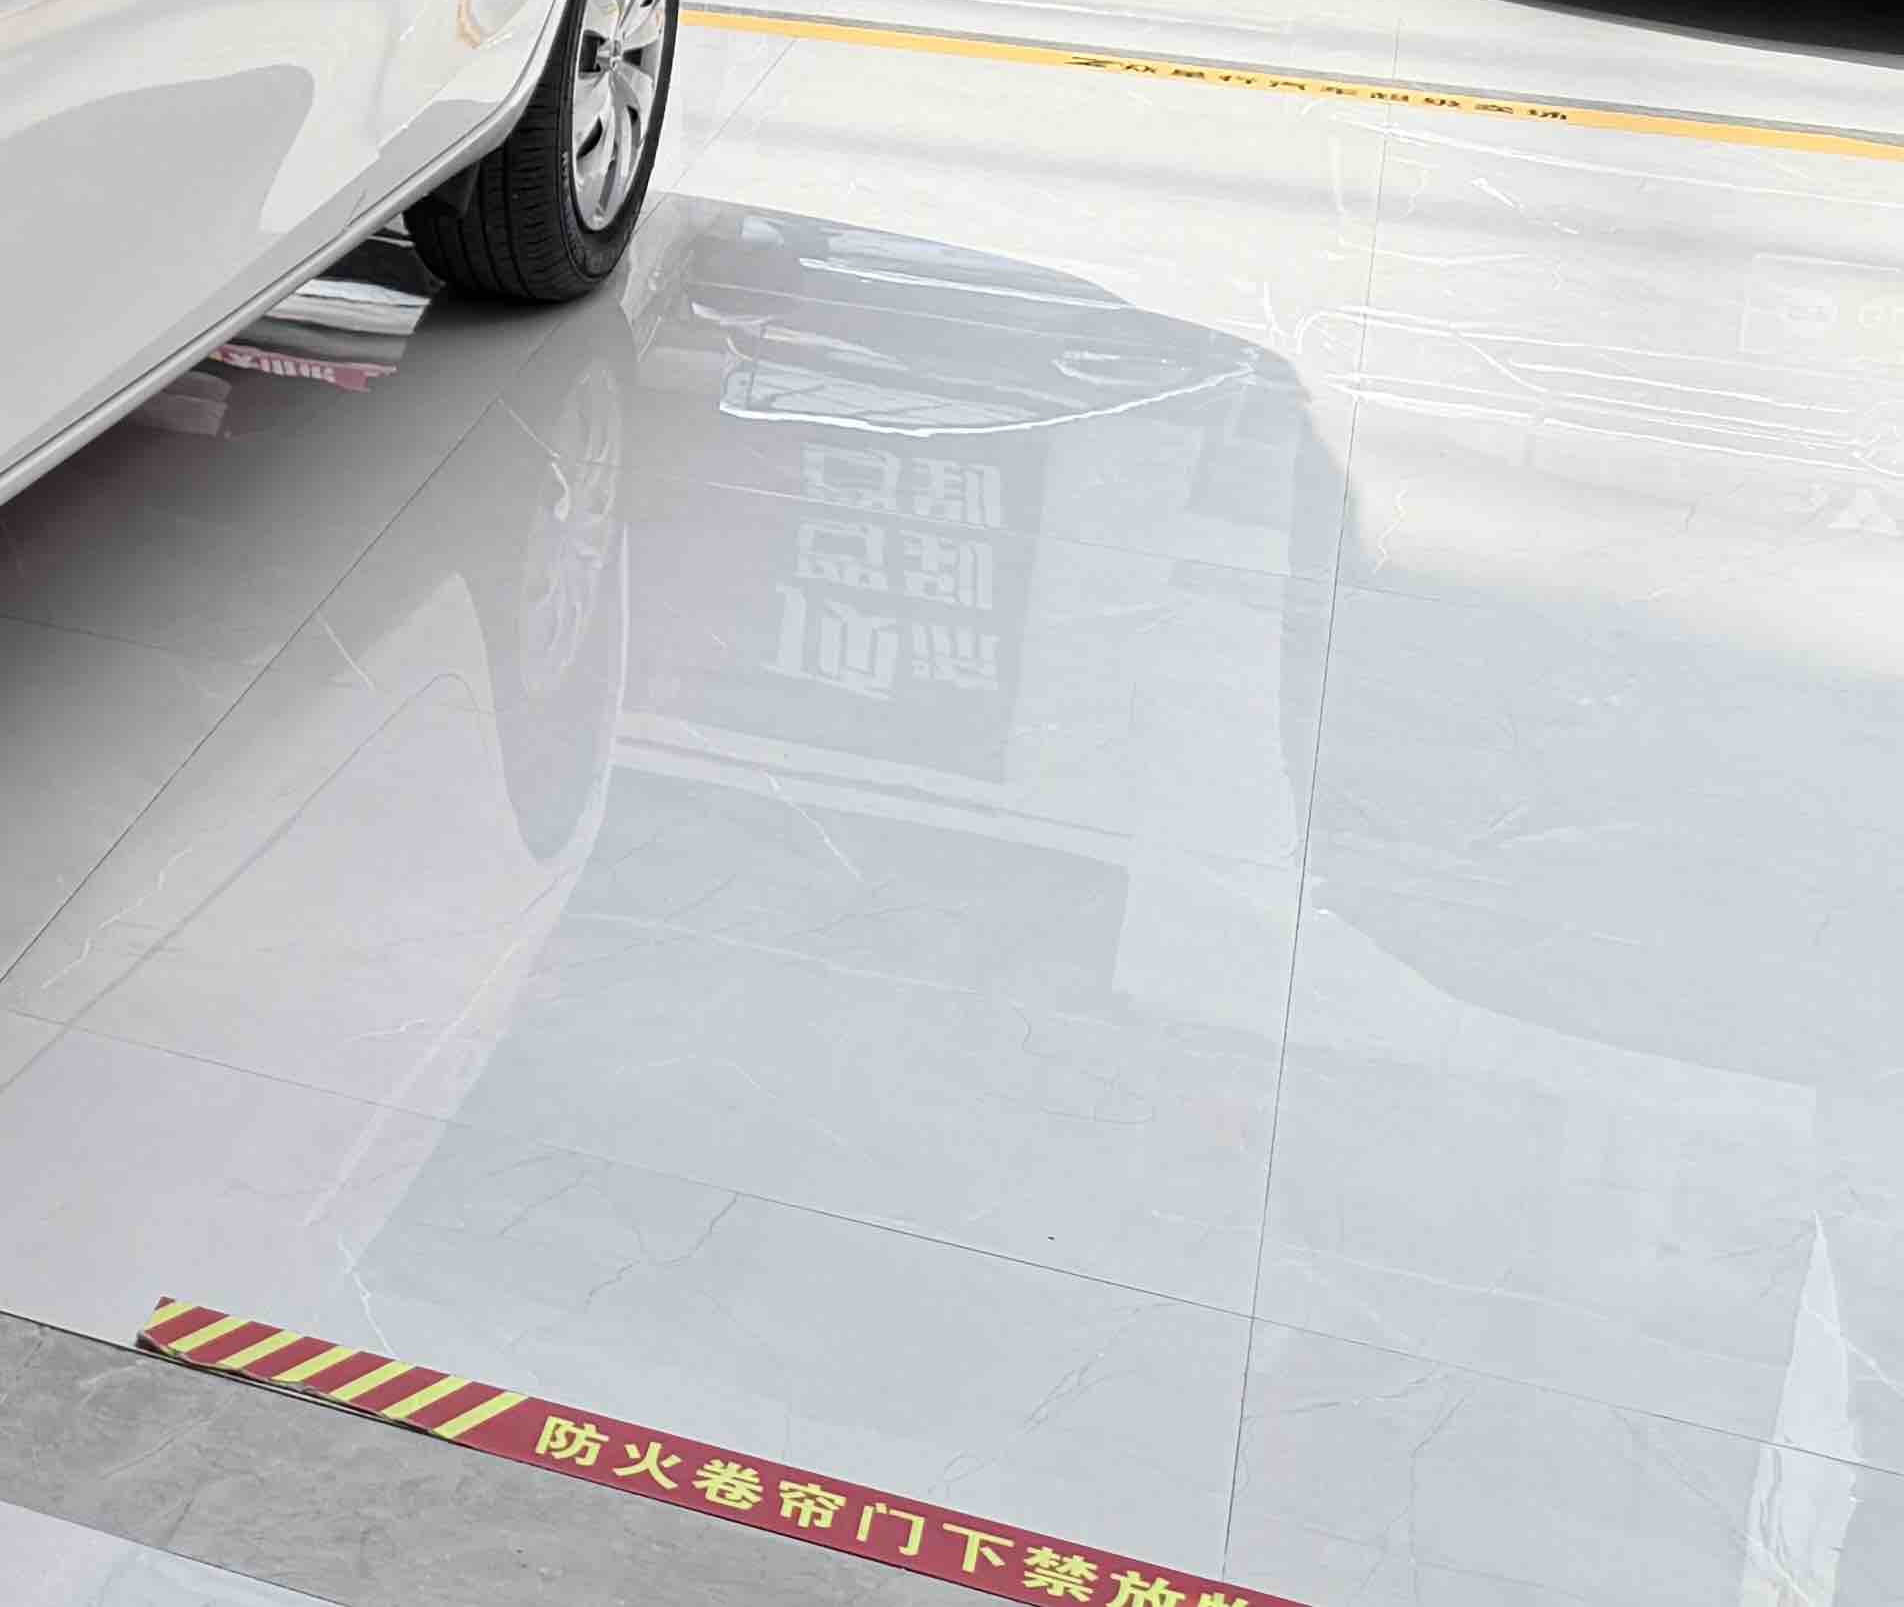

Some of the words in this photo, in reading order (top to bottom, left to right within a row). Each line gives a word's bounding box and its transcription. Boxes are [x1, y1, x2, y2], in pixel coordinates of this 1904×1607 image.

[536, 1415, 1255, 1607] 防火卷帘门下禁放
